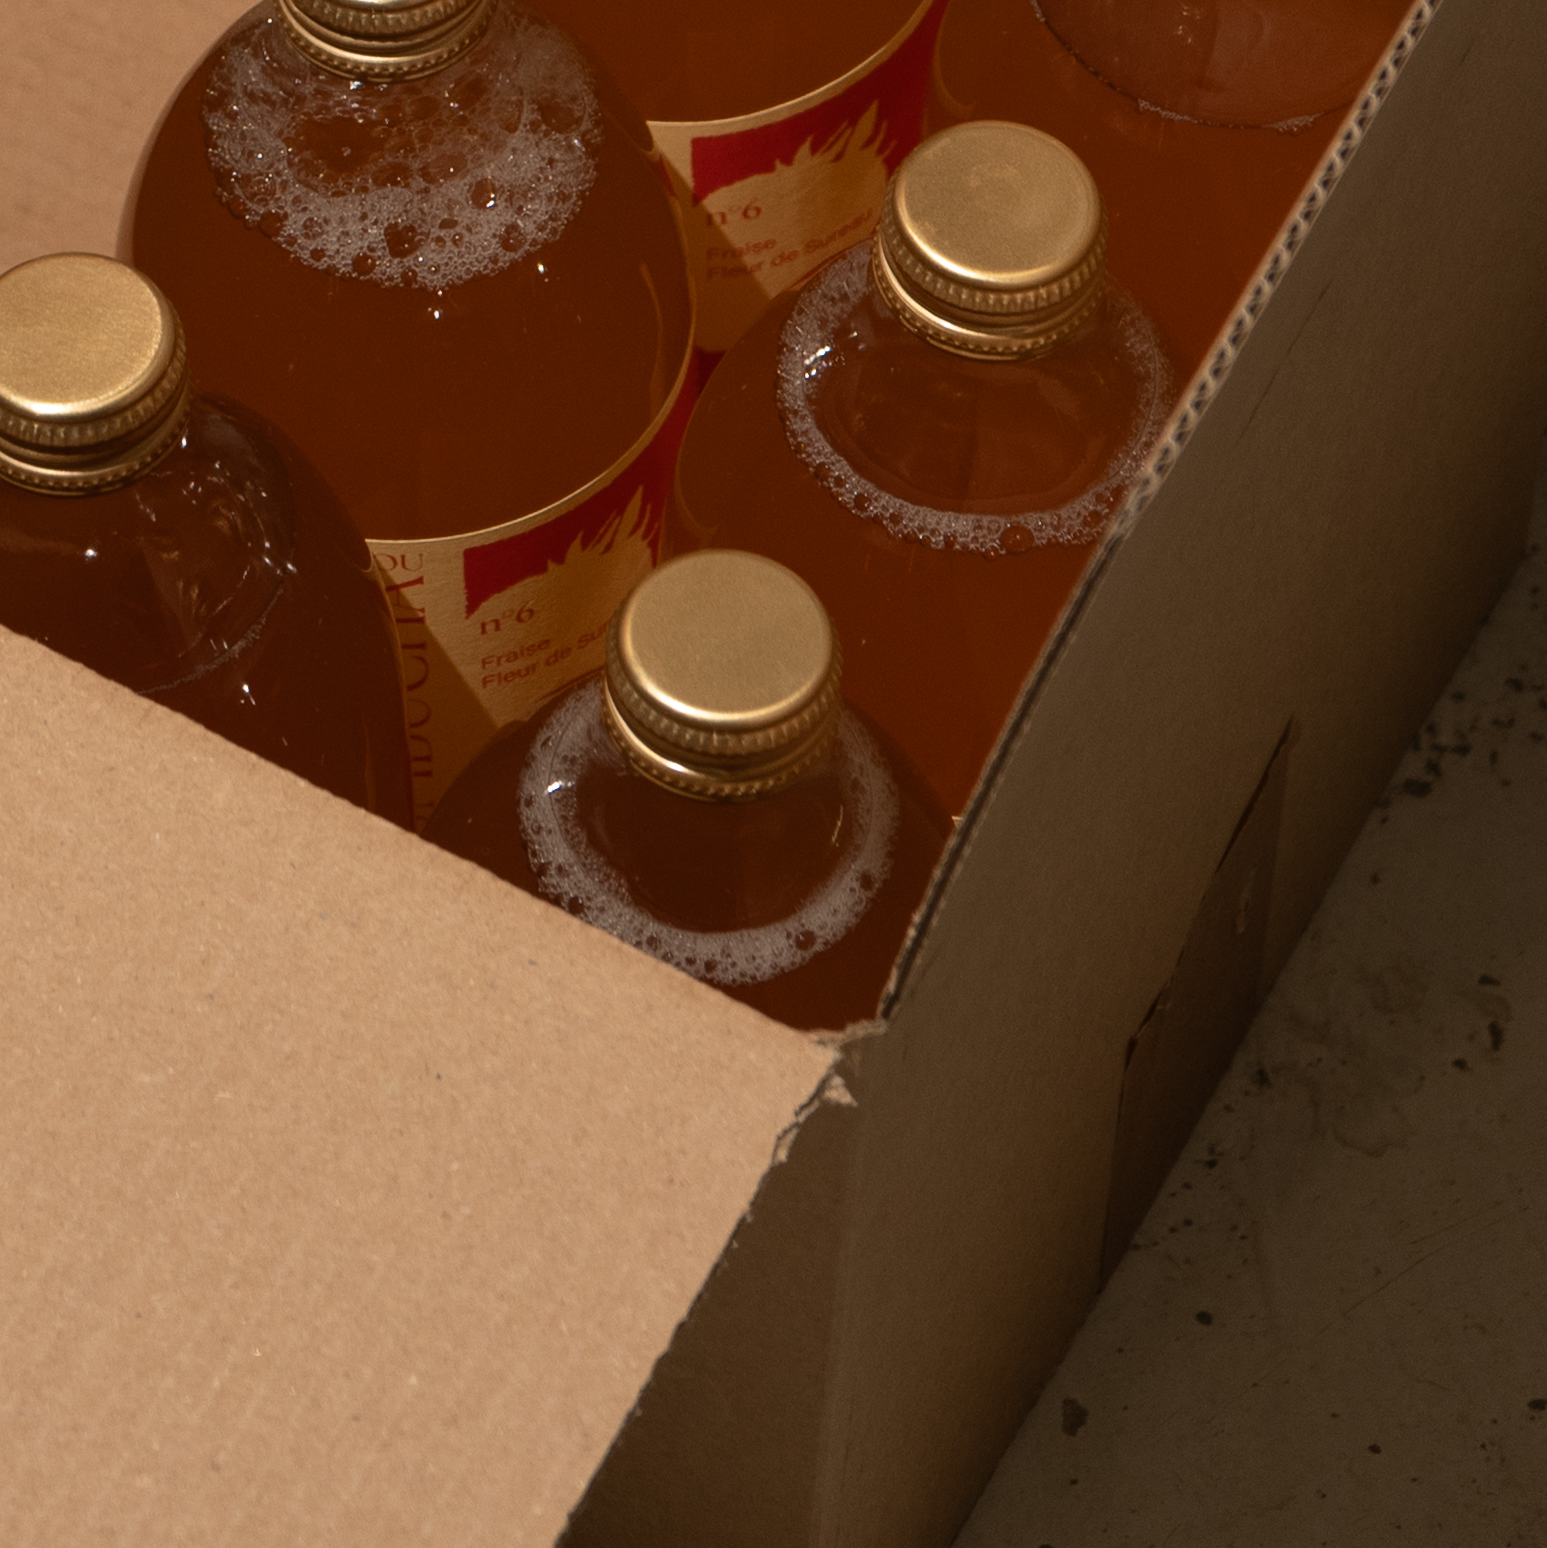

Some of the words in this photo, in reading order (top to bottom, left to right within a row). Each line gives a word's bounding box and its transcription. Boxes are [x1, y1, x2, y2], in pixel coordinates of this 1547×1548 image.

[706, 238, 777, 258] Fraise
[770, 249, 800, 268] de
[804, 208, 874, 254] Sureau
[480, 601, 535, 636] n°6
[481, 637, 552, 670] Fraise
[481, 663, 538, 689] Fleur
[544, 646, 572, 667] de
